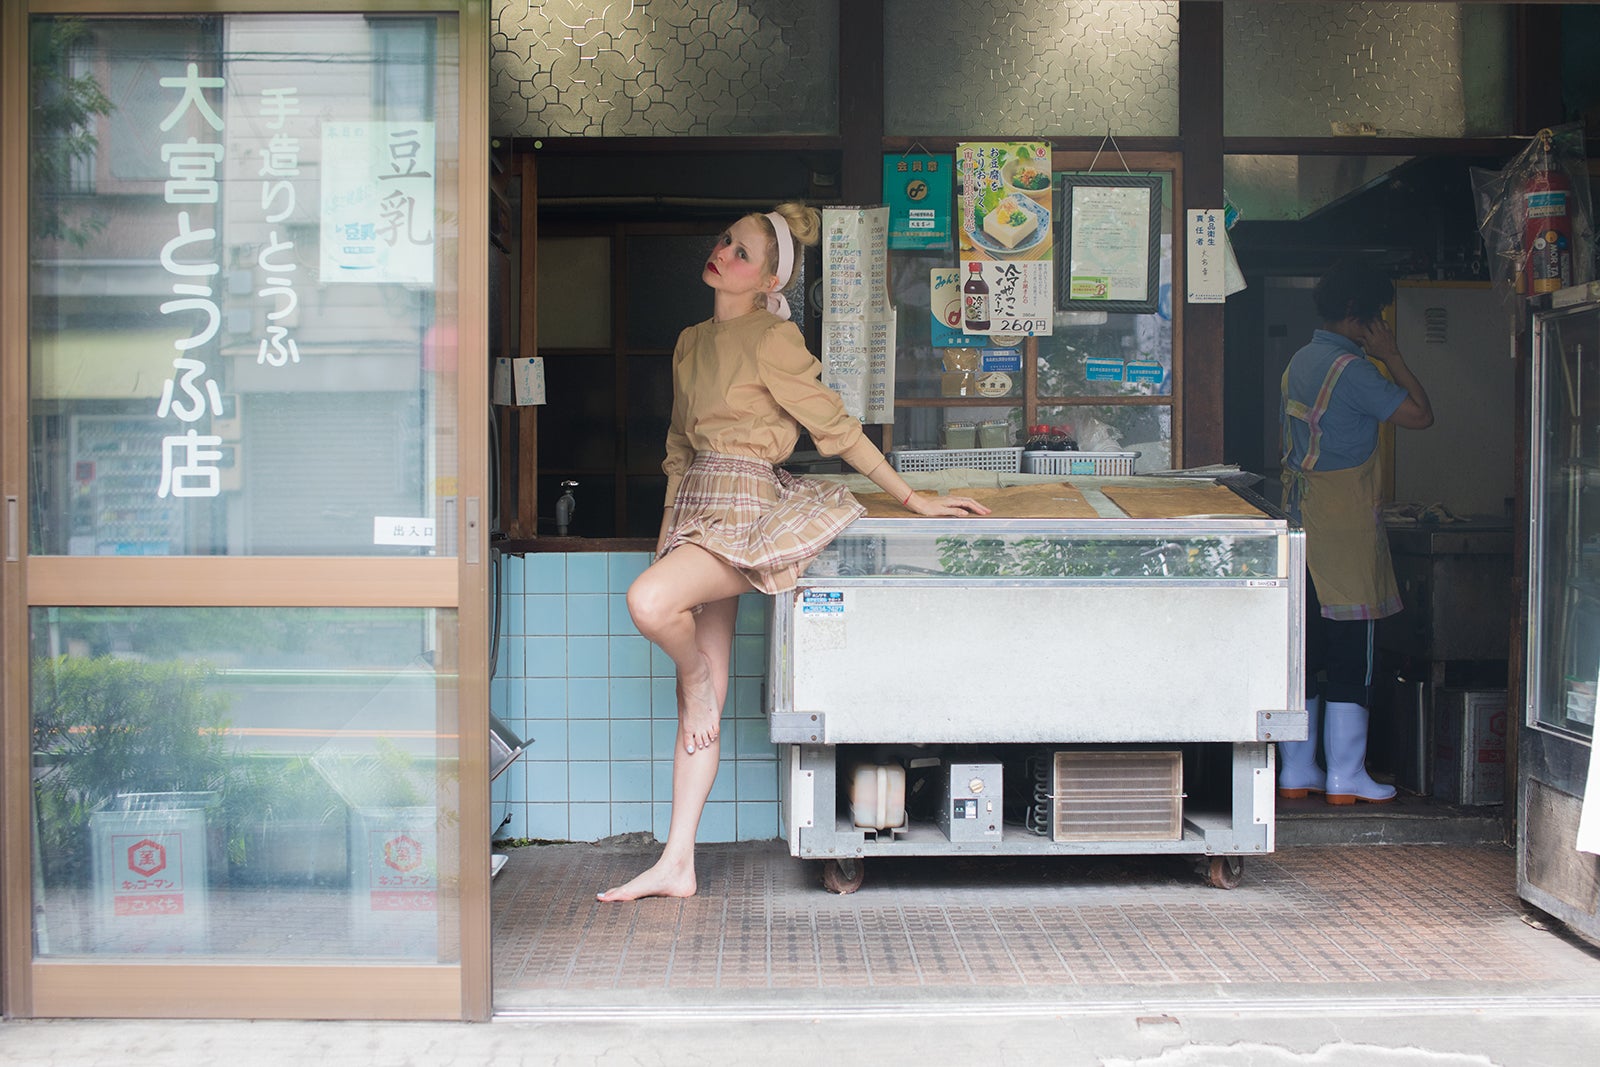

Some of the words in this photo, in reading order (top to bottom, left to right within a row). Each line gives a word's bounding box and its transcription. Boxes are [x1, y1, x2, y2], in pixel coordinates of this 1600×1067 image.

[990, 147, 1000, 192] お豆腐を
[375, 129, 435, 247] 豆乳
[257, 87, 301, 367] 手造りとうふ
[1195, 215, 1204, 246] 責任者
[1207, 215, 1216, 246] 食品衛生
[157, 63, 226, 498] 大宮とうふ店
[1001, 319, 1046, 332] 260円
[393, 525, 433, 537] 出入口
[121, 879, 175, 890] キッコーマン
